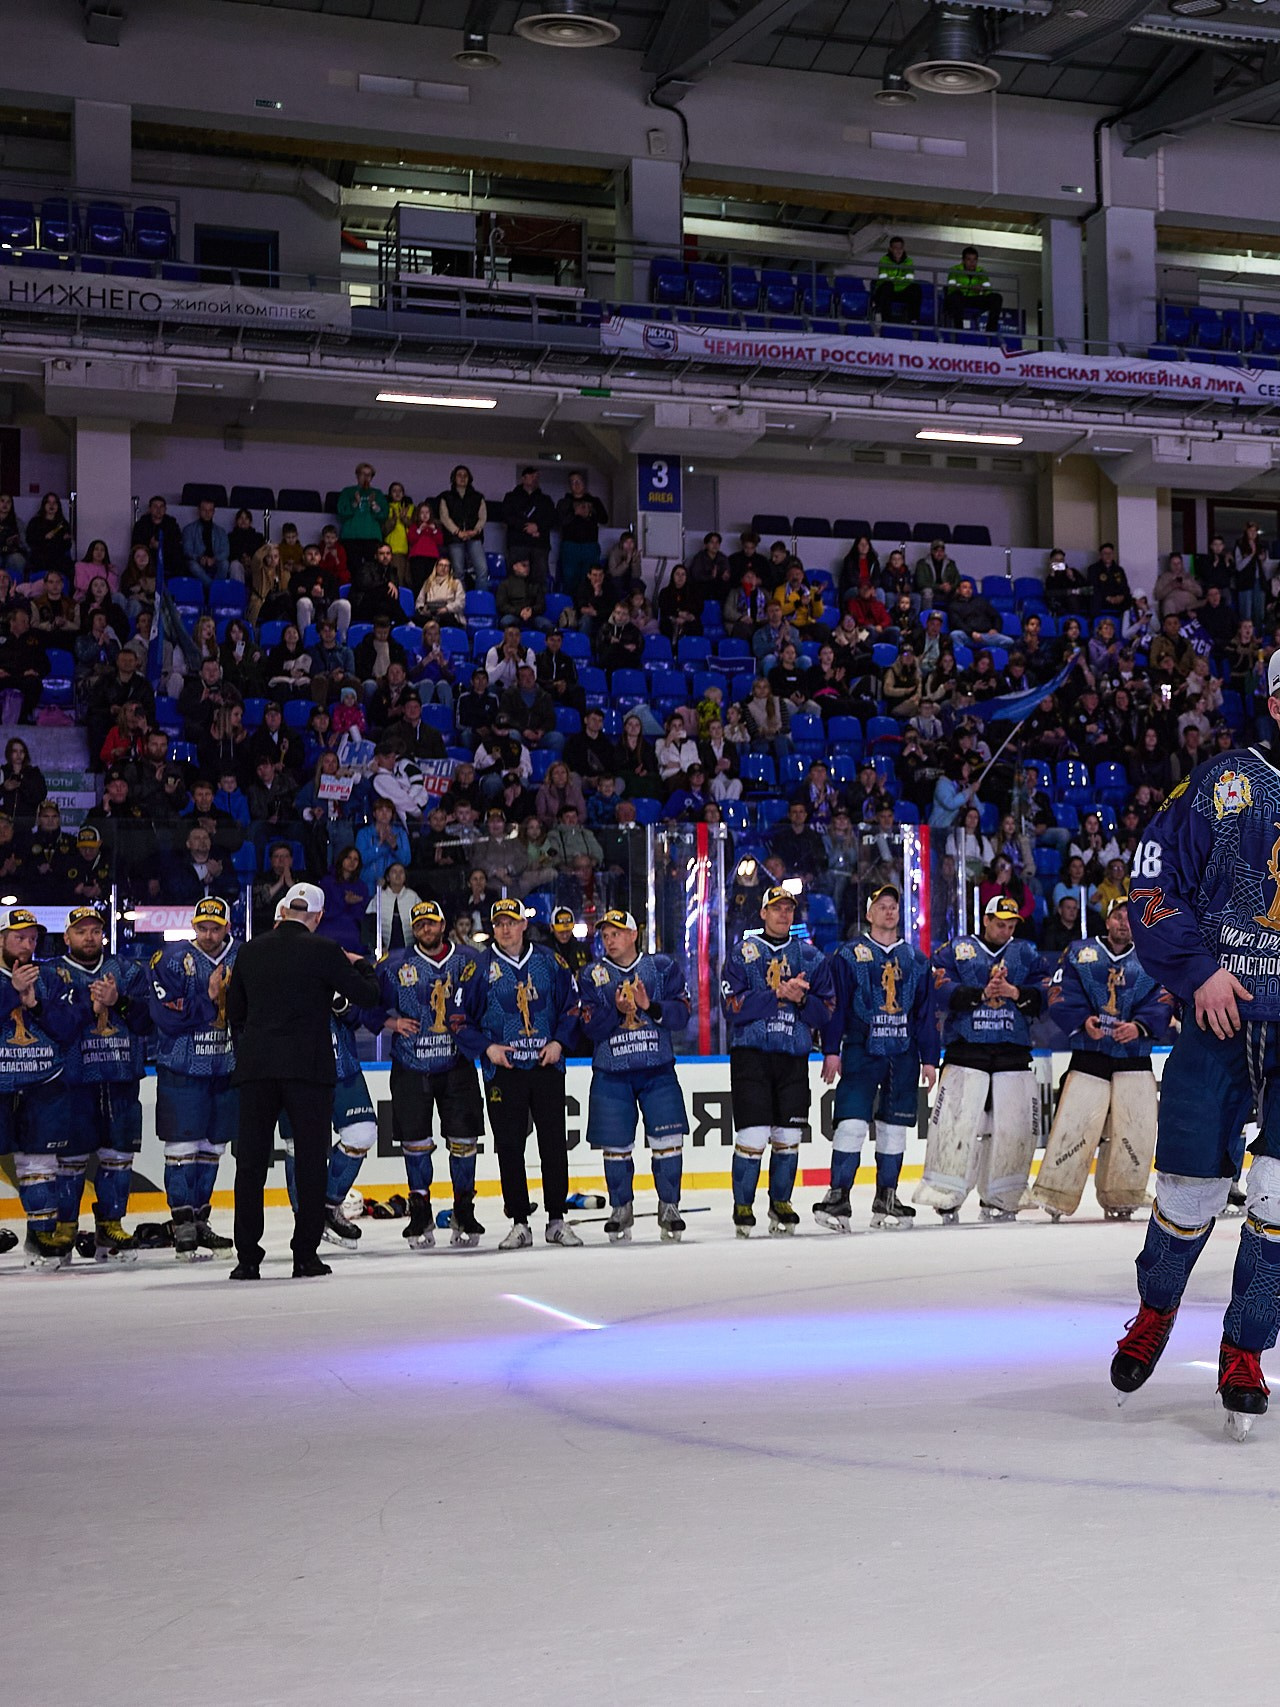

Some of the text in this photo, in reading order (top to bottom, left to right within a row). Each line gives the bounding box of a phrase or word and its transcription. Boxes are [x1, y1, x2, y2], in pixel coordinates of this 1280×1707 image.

[9, 280, 164, 312] НИЖНЕГО
[171, 298, 317, 320] ЖИЛОЙ КОМПЛЕКС
[704, 339, 816, 361] ЧЕМПИОНАТ
[821, 348, 894, 366] РОССИИ
[900, 355, 924, 368] ПО
[928, 356, 1001, 374] ХОККЕЮ
[1019, 364, 1100, 381] ЖЕНСКАЯ
[1105, 369, 1201, 390] ХОККЕЙНАЯ
[1207, 378, 1246, 394] ЛИГА
[652, 460, 669, 488] 3
[648, 491, 673, 504] AREA
